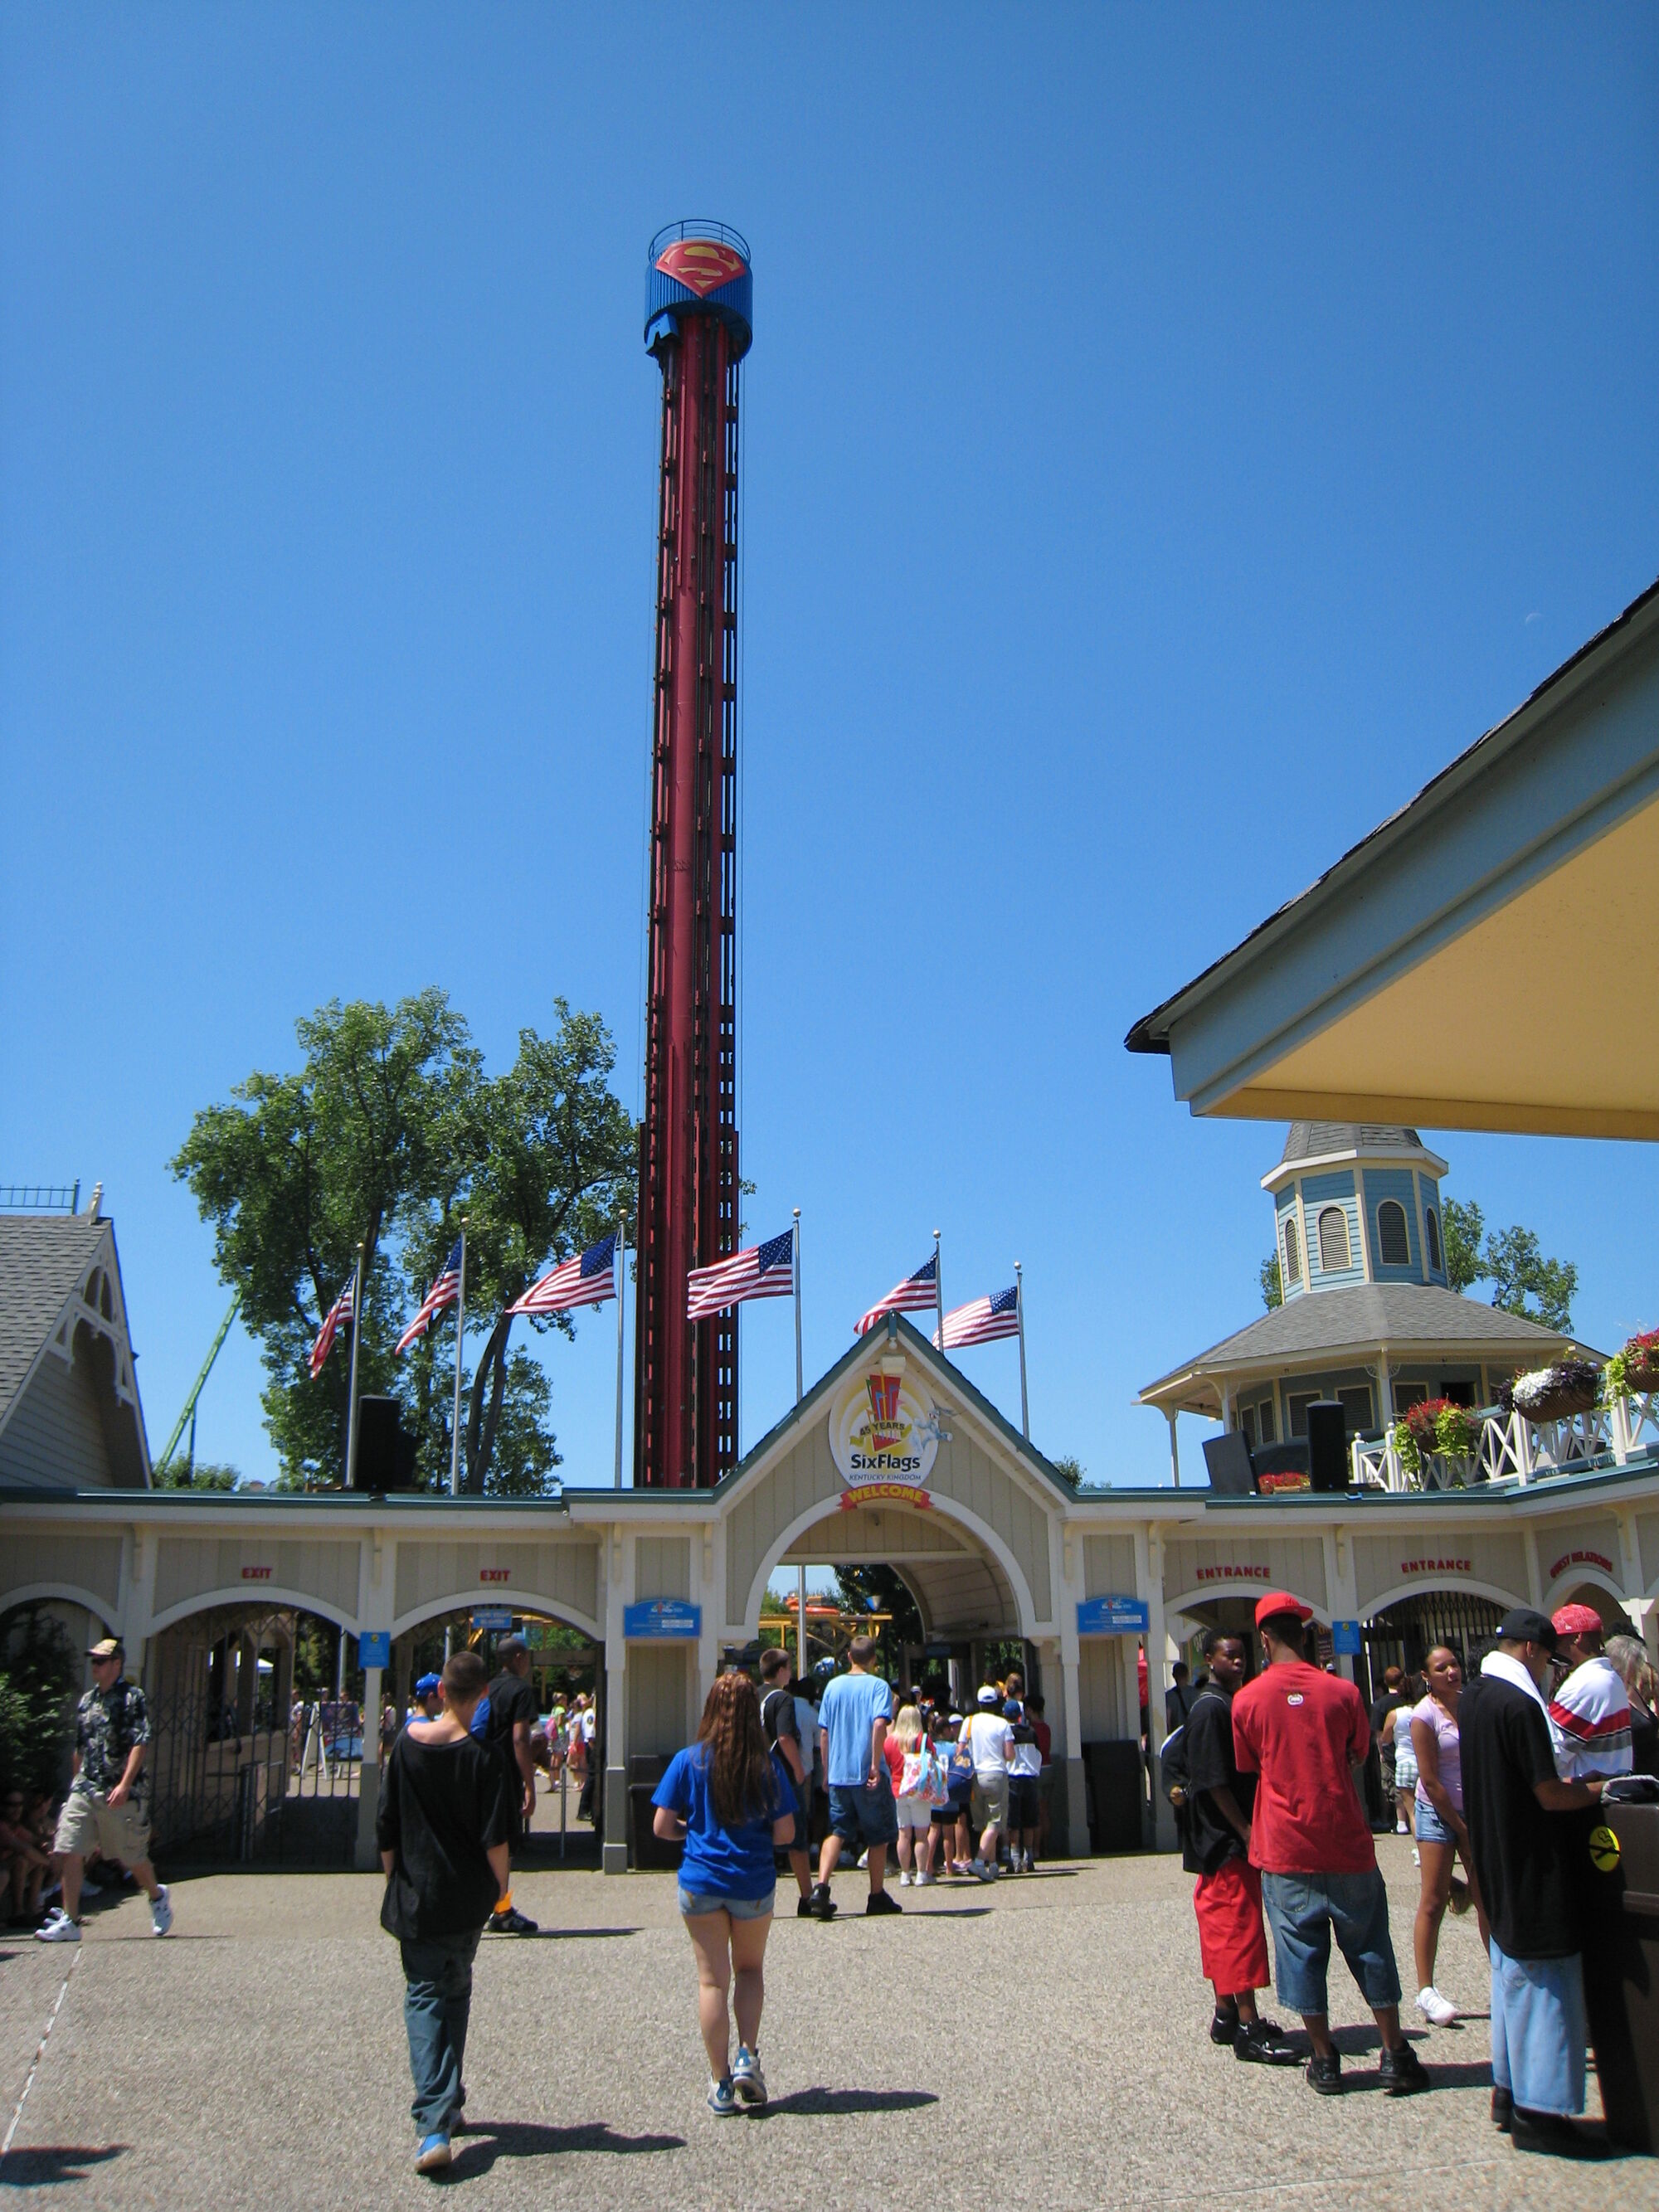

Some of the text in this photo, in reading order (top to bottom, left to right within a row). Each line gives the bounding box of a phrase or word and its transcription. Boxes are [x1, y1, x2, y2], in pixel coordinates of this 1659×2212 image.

[860, 1422, 905, 1436] 45 YEARS
[851, 1454, 920, 1471] SixFlags
[848, 1485, 923, 1503] WELCOME
[241, 1568, 272, 1579] EXIT
[1196, 1566, 1271, 1580] ENTRANCE
[1401, 1559, 1472, 1574] ENTRANCE
[480, 1570, 510, 1581] EXIT
